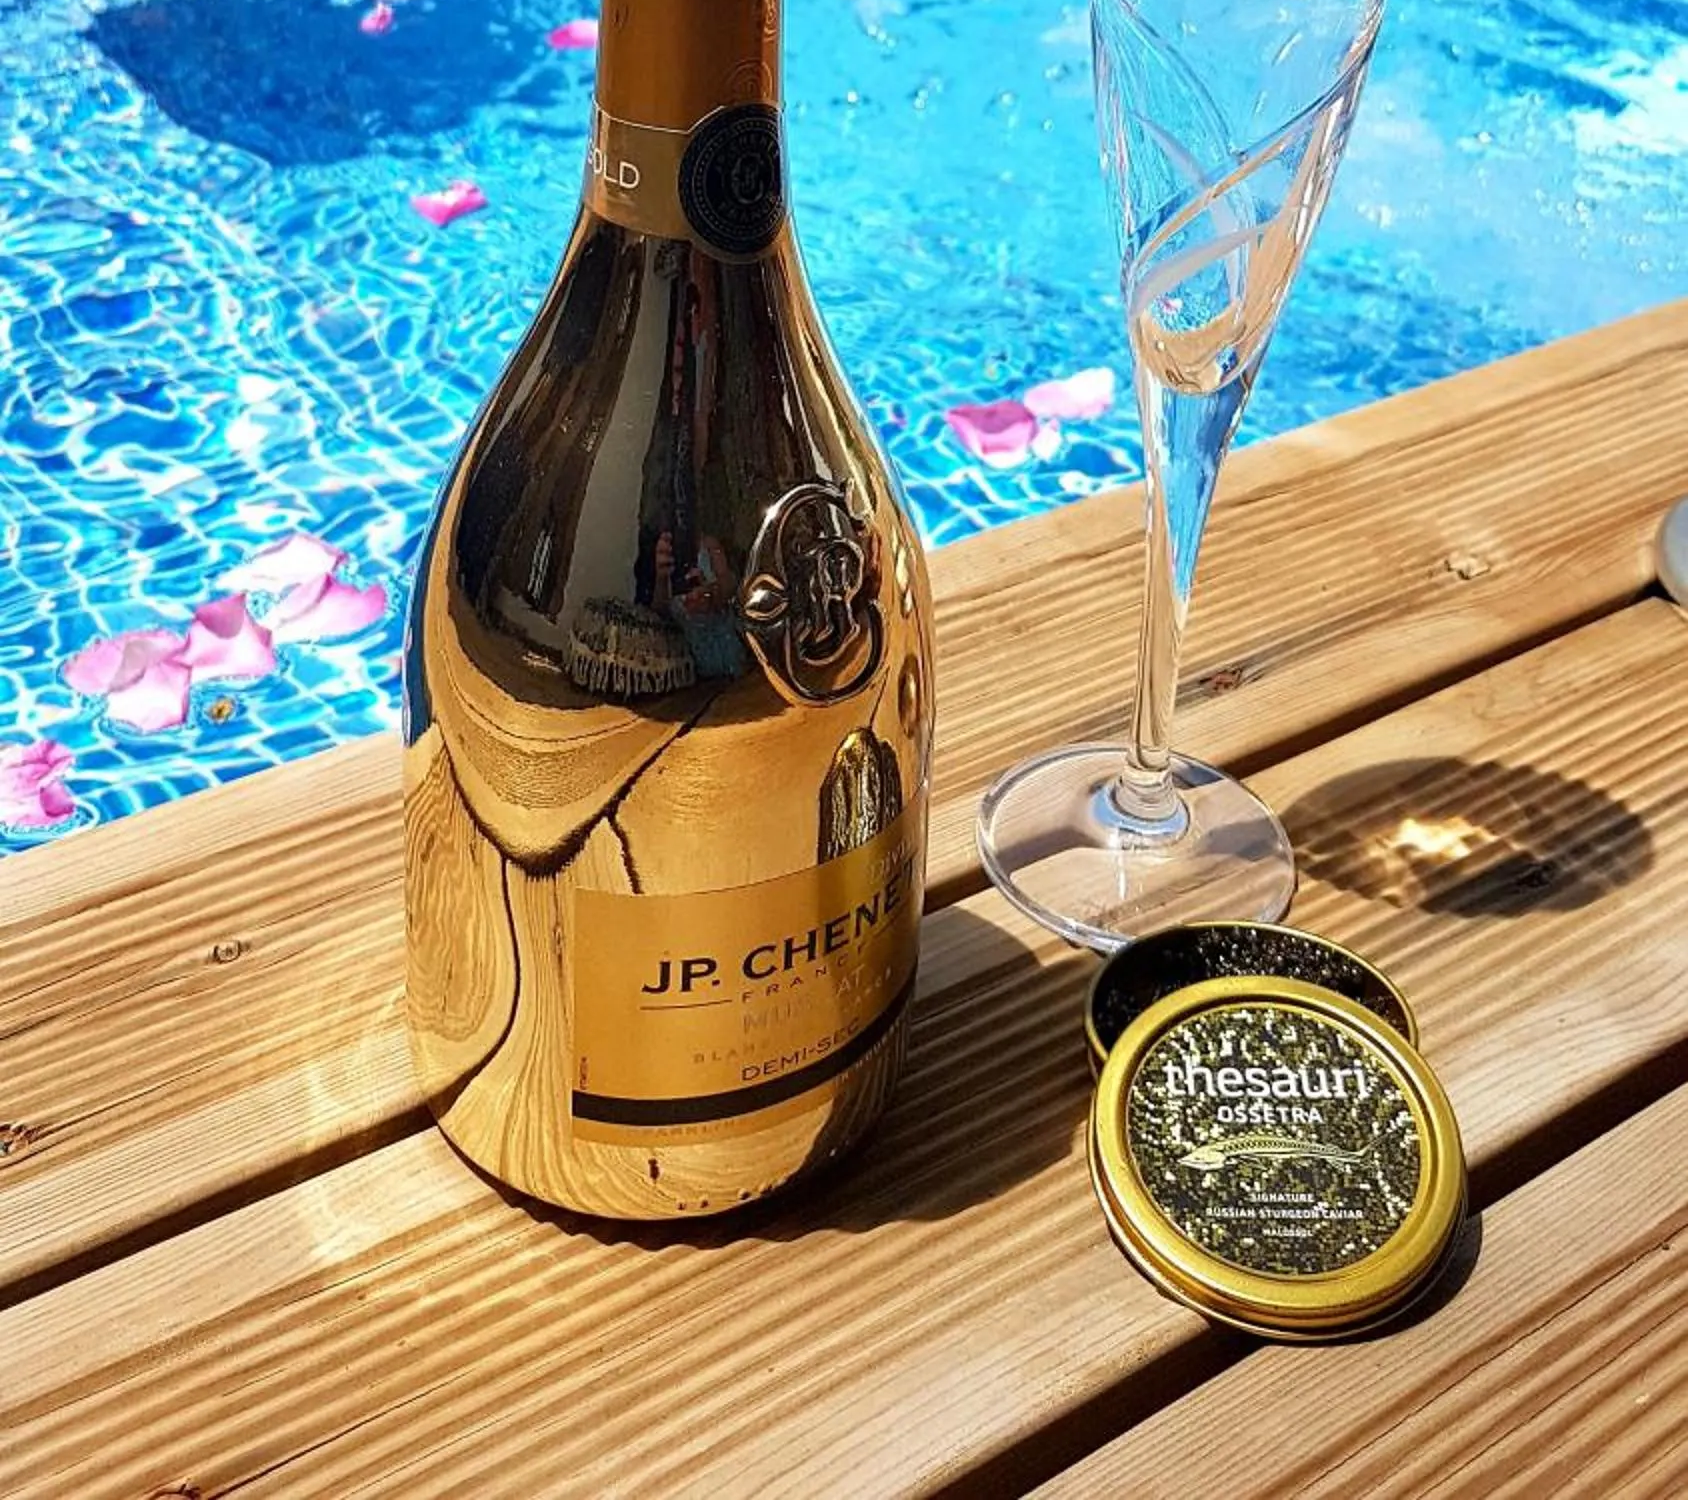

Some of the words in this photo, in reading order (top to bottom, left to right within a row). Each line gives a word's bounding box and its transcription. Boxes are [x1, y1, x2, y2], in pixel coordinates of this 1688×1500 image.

[641, 957, 721, 994] JP.
[741, 1016, 861, 1082] DEMI-SEC
[1161, 1054, 1371, 1100] thesauri
[1216, 1105, 1324, 1124] OSSETRA
[1251, 1192, 1315, 1203] SIGNATURE
[1205, 1207, 1256, 1218] RUSSIAN
[1258, 1208, 1320, 1219] STURGEON
[1322, 1208, 1365, 1219] CAVIAR
